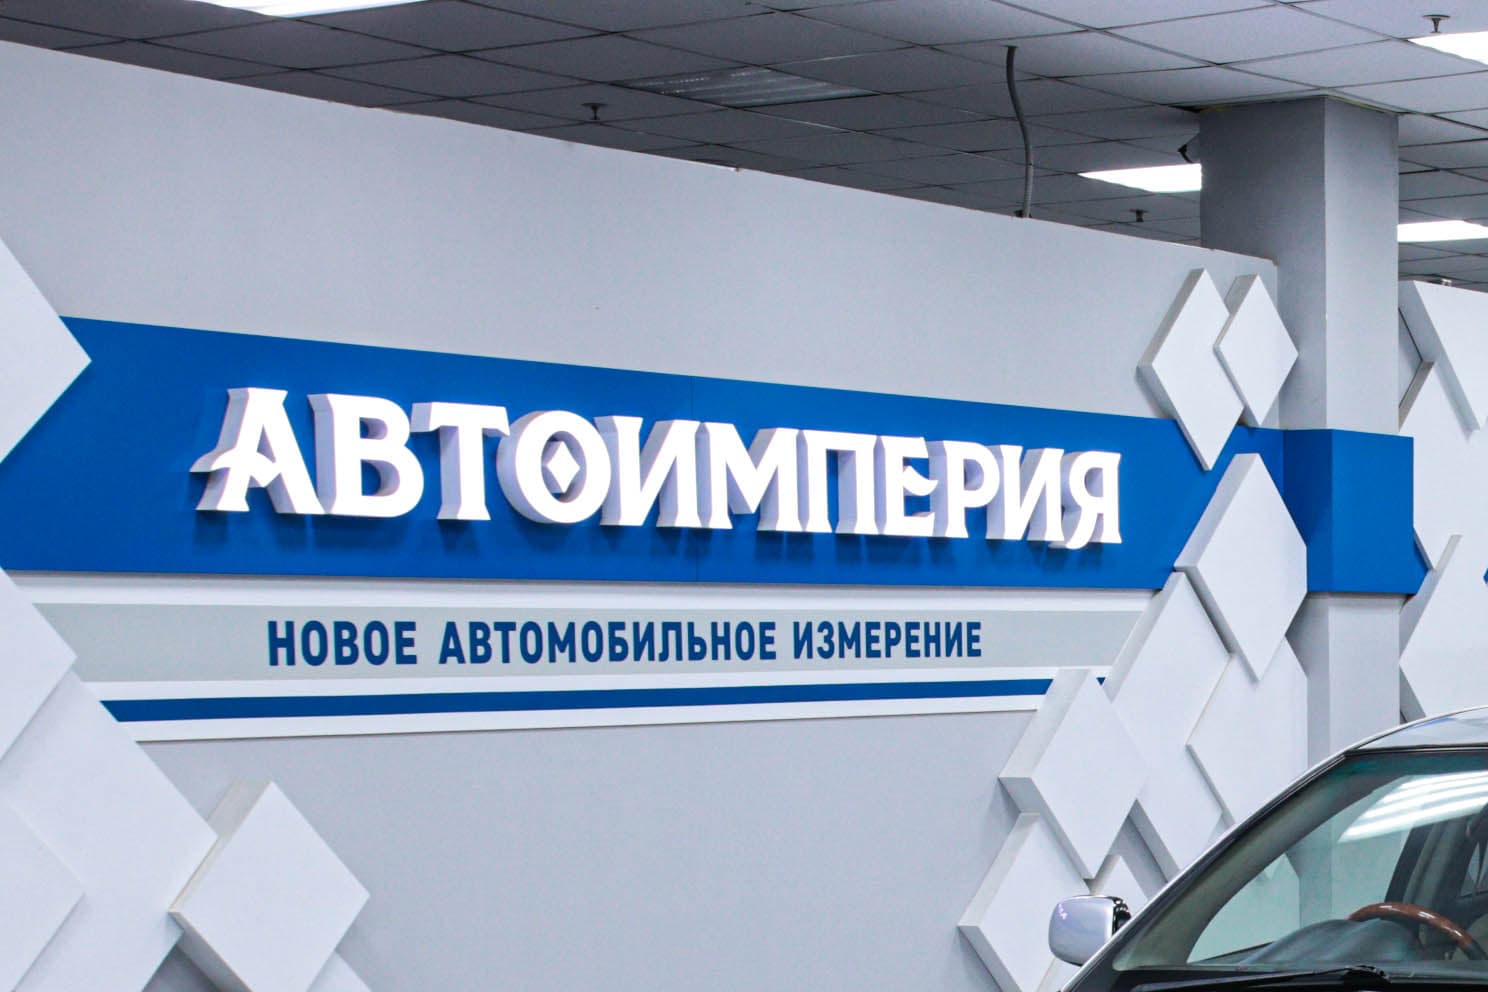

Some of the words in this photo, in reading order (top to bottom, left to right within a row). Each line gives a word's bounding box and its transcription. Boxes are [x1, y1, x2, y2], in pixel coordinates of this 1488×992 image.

[190, 387, 1121, 549] АВТОИМПЕРИЯ
[267, 620, 417, 666] НОВОЕ
[439, 620, 777, 665] АВТОМОБИЛЬНОЕ
[793, 621, 982, 660] ИЗМЕРЕНИЕ
